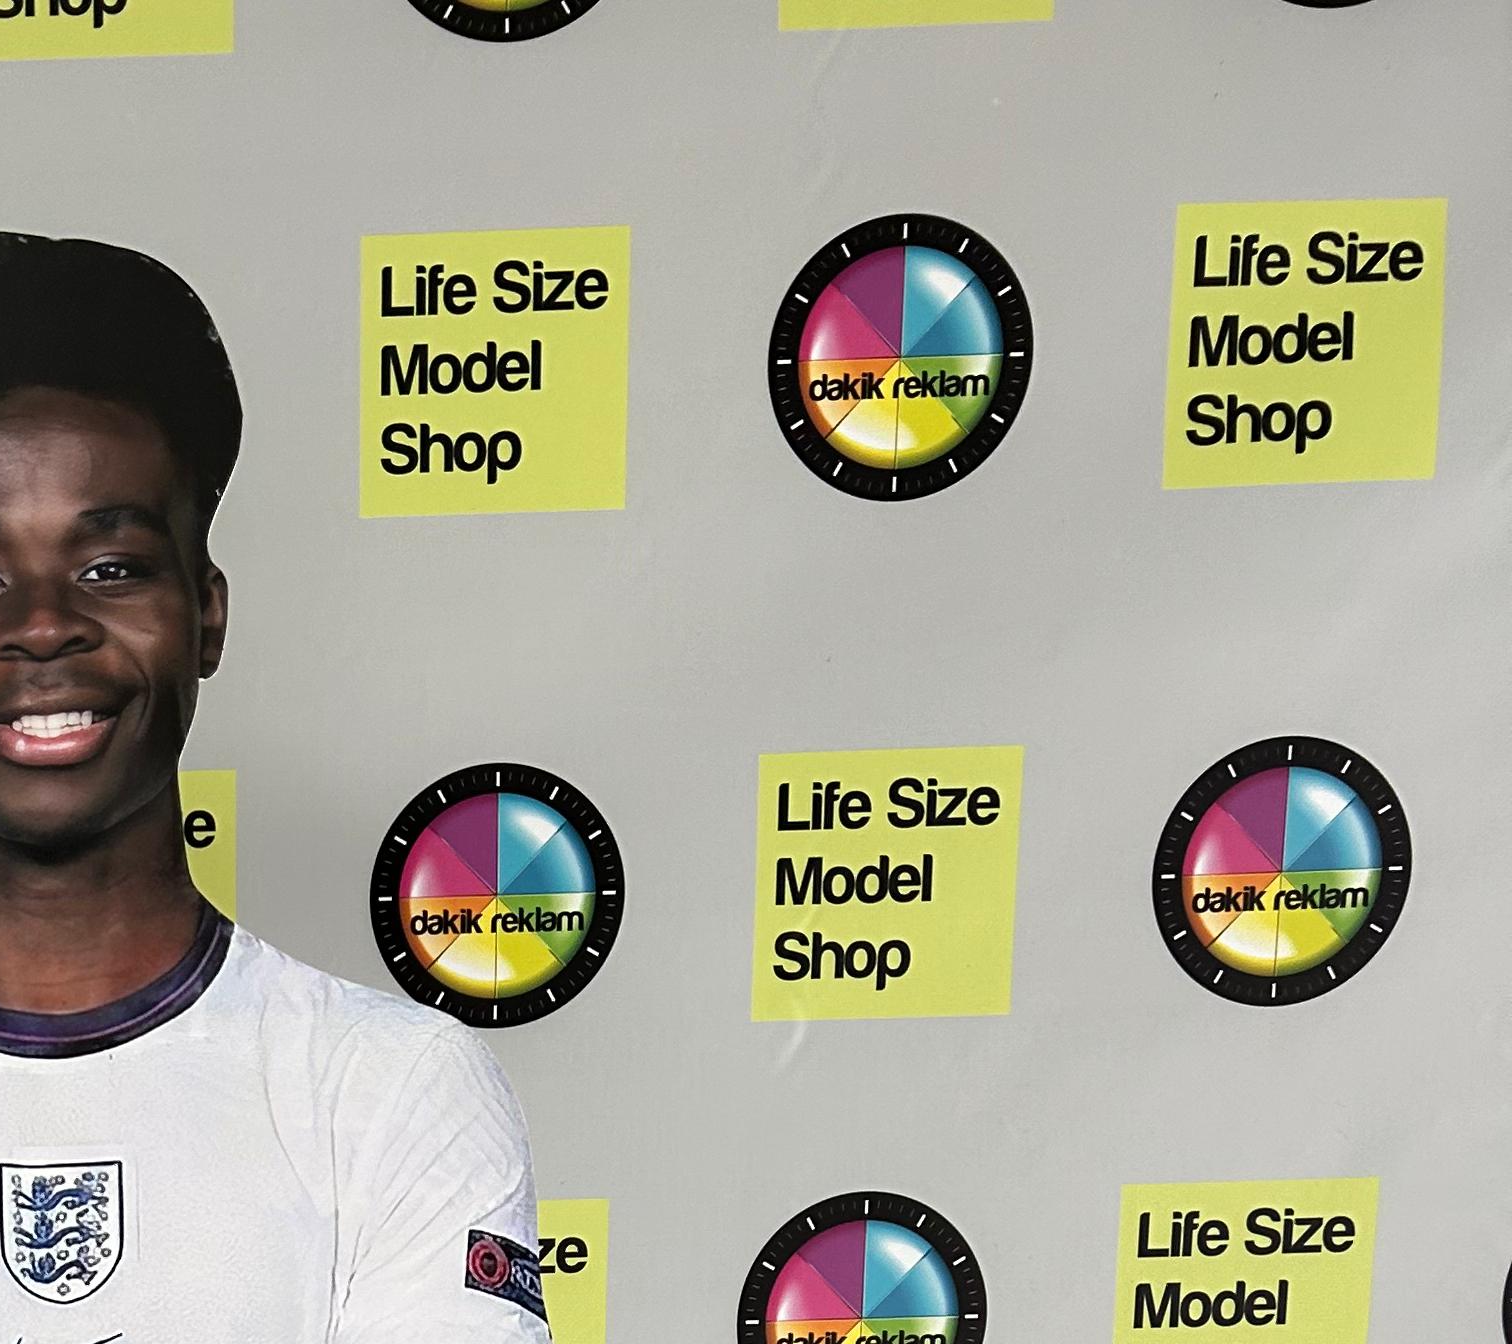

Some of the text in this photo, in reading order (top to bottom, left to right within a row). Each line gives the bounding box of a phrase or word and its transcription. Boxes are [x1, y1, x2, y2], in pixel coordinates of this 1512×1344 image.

[1193, 231, 1424, 288] Life Size
[381, 260, 609, 318] Life Size
[1187, 310, 1355, 368] Model
[380, 339, 542, 397] Model
[808, 369, 991, 402] dakik reklam
[1185, 393, 1333, 455] Shop
[380, 422, 522, 485] Shop
[777, 777, 1001, 832] Life Size
[775, 853, 934, 906] Model
[1191, 883, 1369, 914] dakik reklam
[410, 906, 585, 936] dakik reklam
[772, 930, 911, 991] Shop
[537, 1236, 589, 1274] ze
[1137, 1207, 1356, 1259] Life Size
[1133, 1279, 1289, 1329] Model
